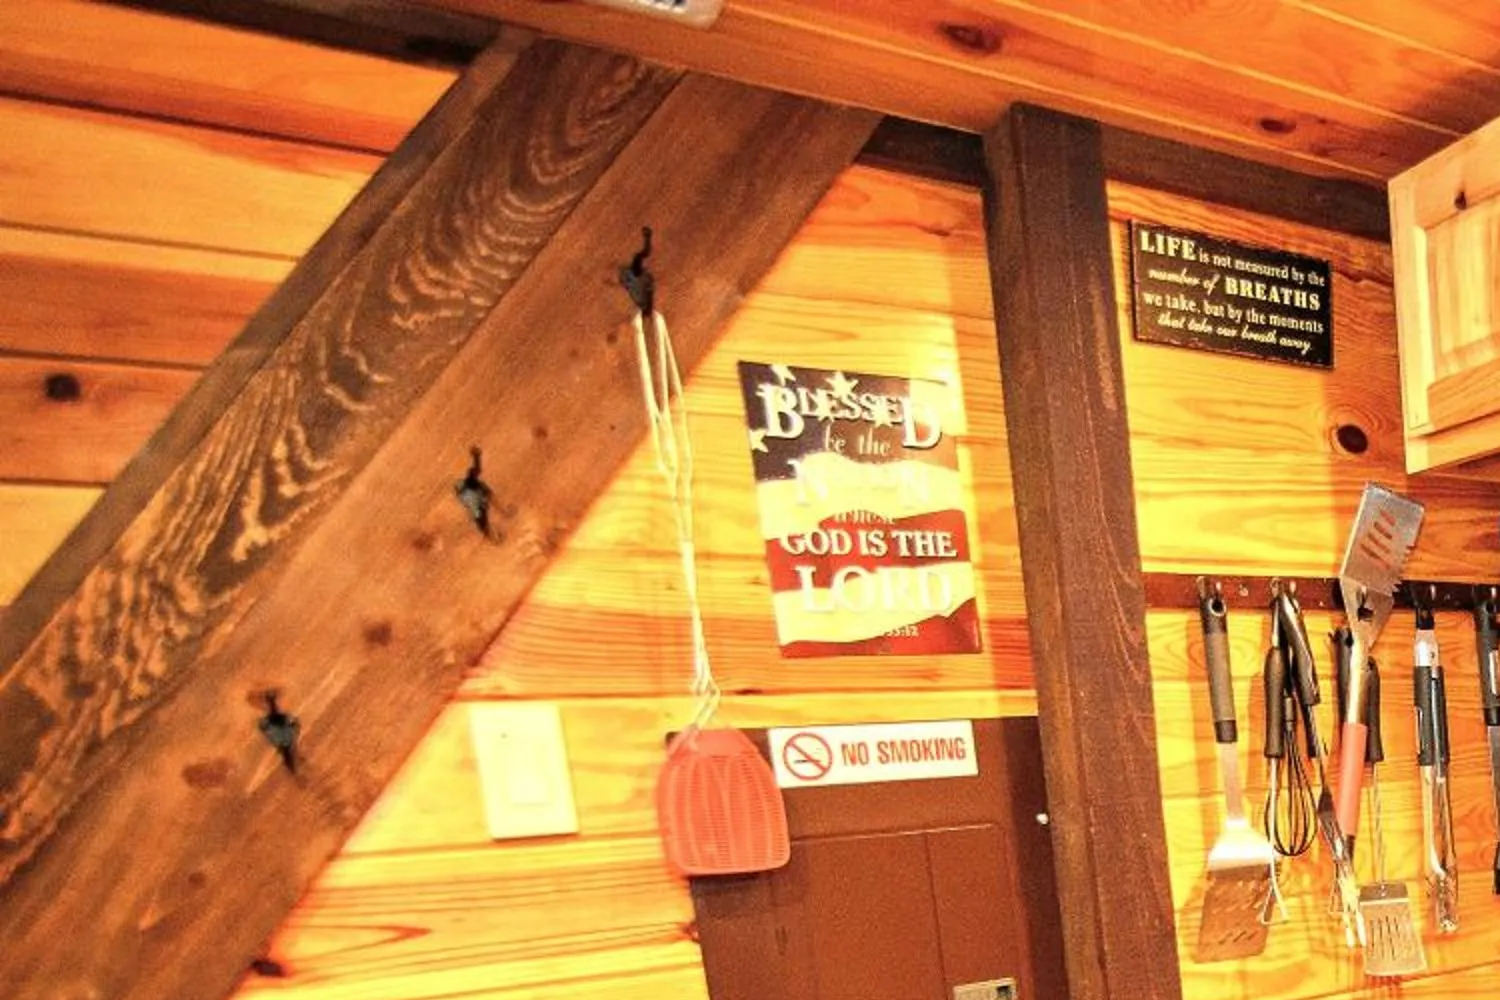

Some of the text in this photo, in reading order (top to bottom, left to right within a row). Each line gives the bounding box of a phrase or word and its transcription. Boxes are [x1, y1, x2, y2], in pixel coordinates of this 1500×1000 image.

[1140, 231, 1326, 287] LIFE is not measured by the
[1148, 268, 1321, 311] number of BREATHS
[1143, 292, 1163, 306] we
[1204, 300, 1225, 317] but
[1228, 305, 1242, 323] by
[1246, 308, 1266, 325] the
[1269, 314, 1325, 335] moments
[756, 382, 942, 450] BLESSED
[780, 528, 957, 558] GOD IS THE
[841, 737, 967, 766] NO SMOKING
